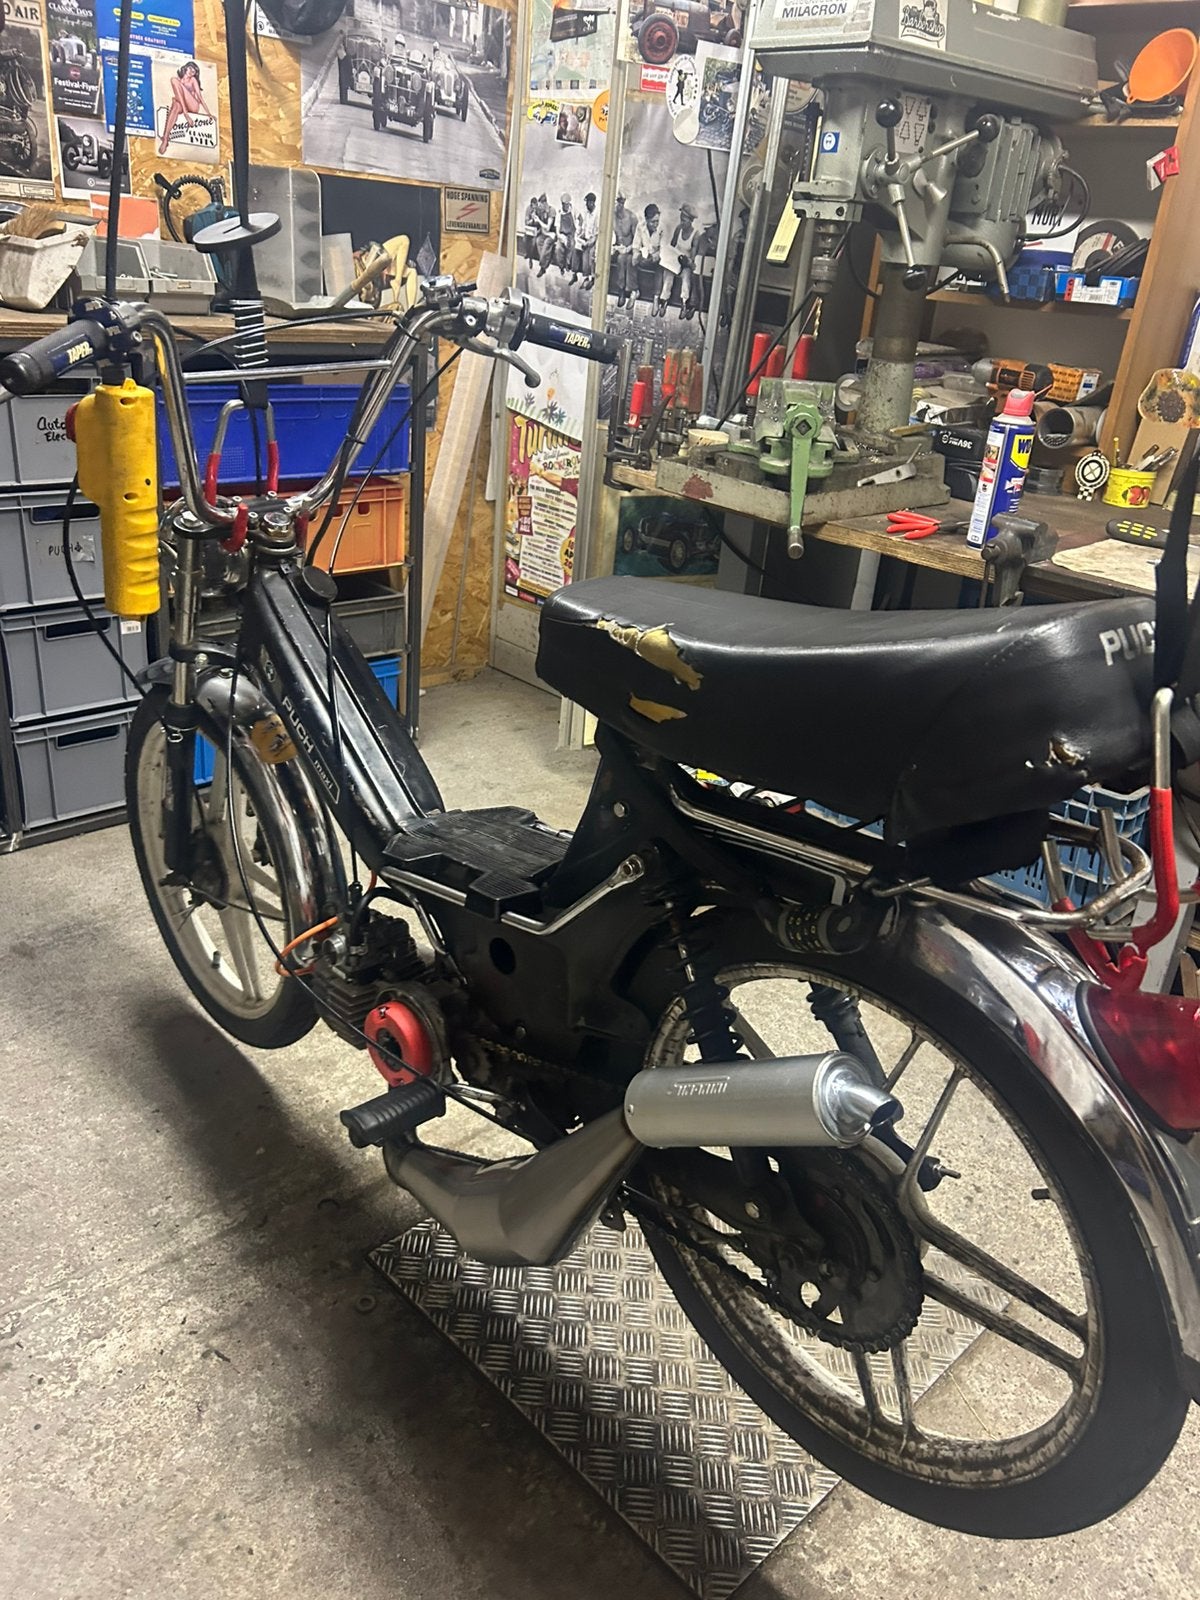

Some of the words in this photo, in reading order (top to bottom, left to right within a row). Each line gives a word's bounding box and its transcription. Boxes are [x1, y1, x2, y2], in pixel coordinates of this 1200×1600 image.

[15, 5, 39, 20] AIR
[782, 3, 847, 18] MILACRON
[901, 5, 945, 37] Barbershop
[564, 332, 592, 349] TAPER
[66, 341, 93, 364] TAPER
[36, 416, 67, 431] Auto
[282, 696, 315, 754] PUCH
[314, 760, 333, 789] maxi
